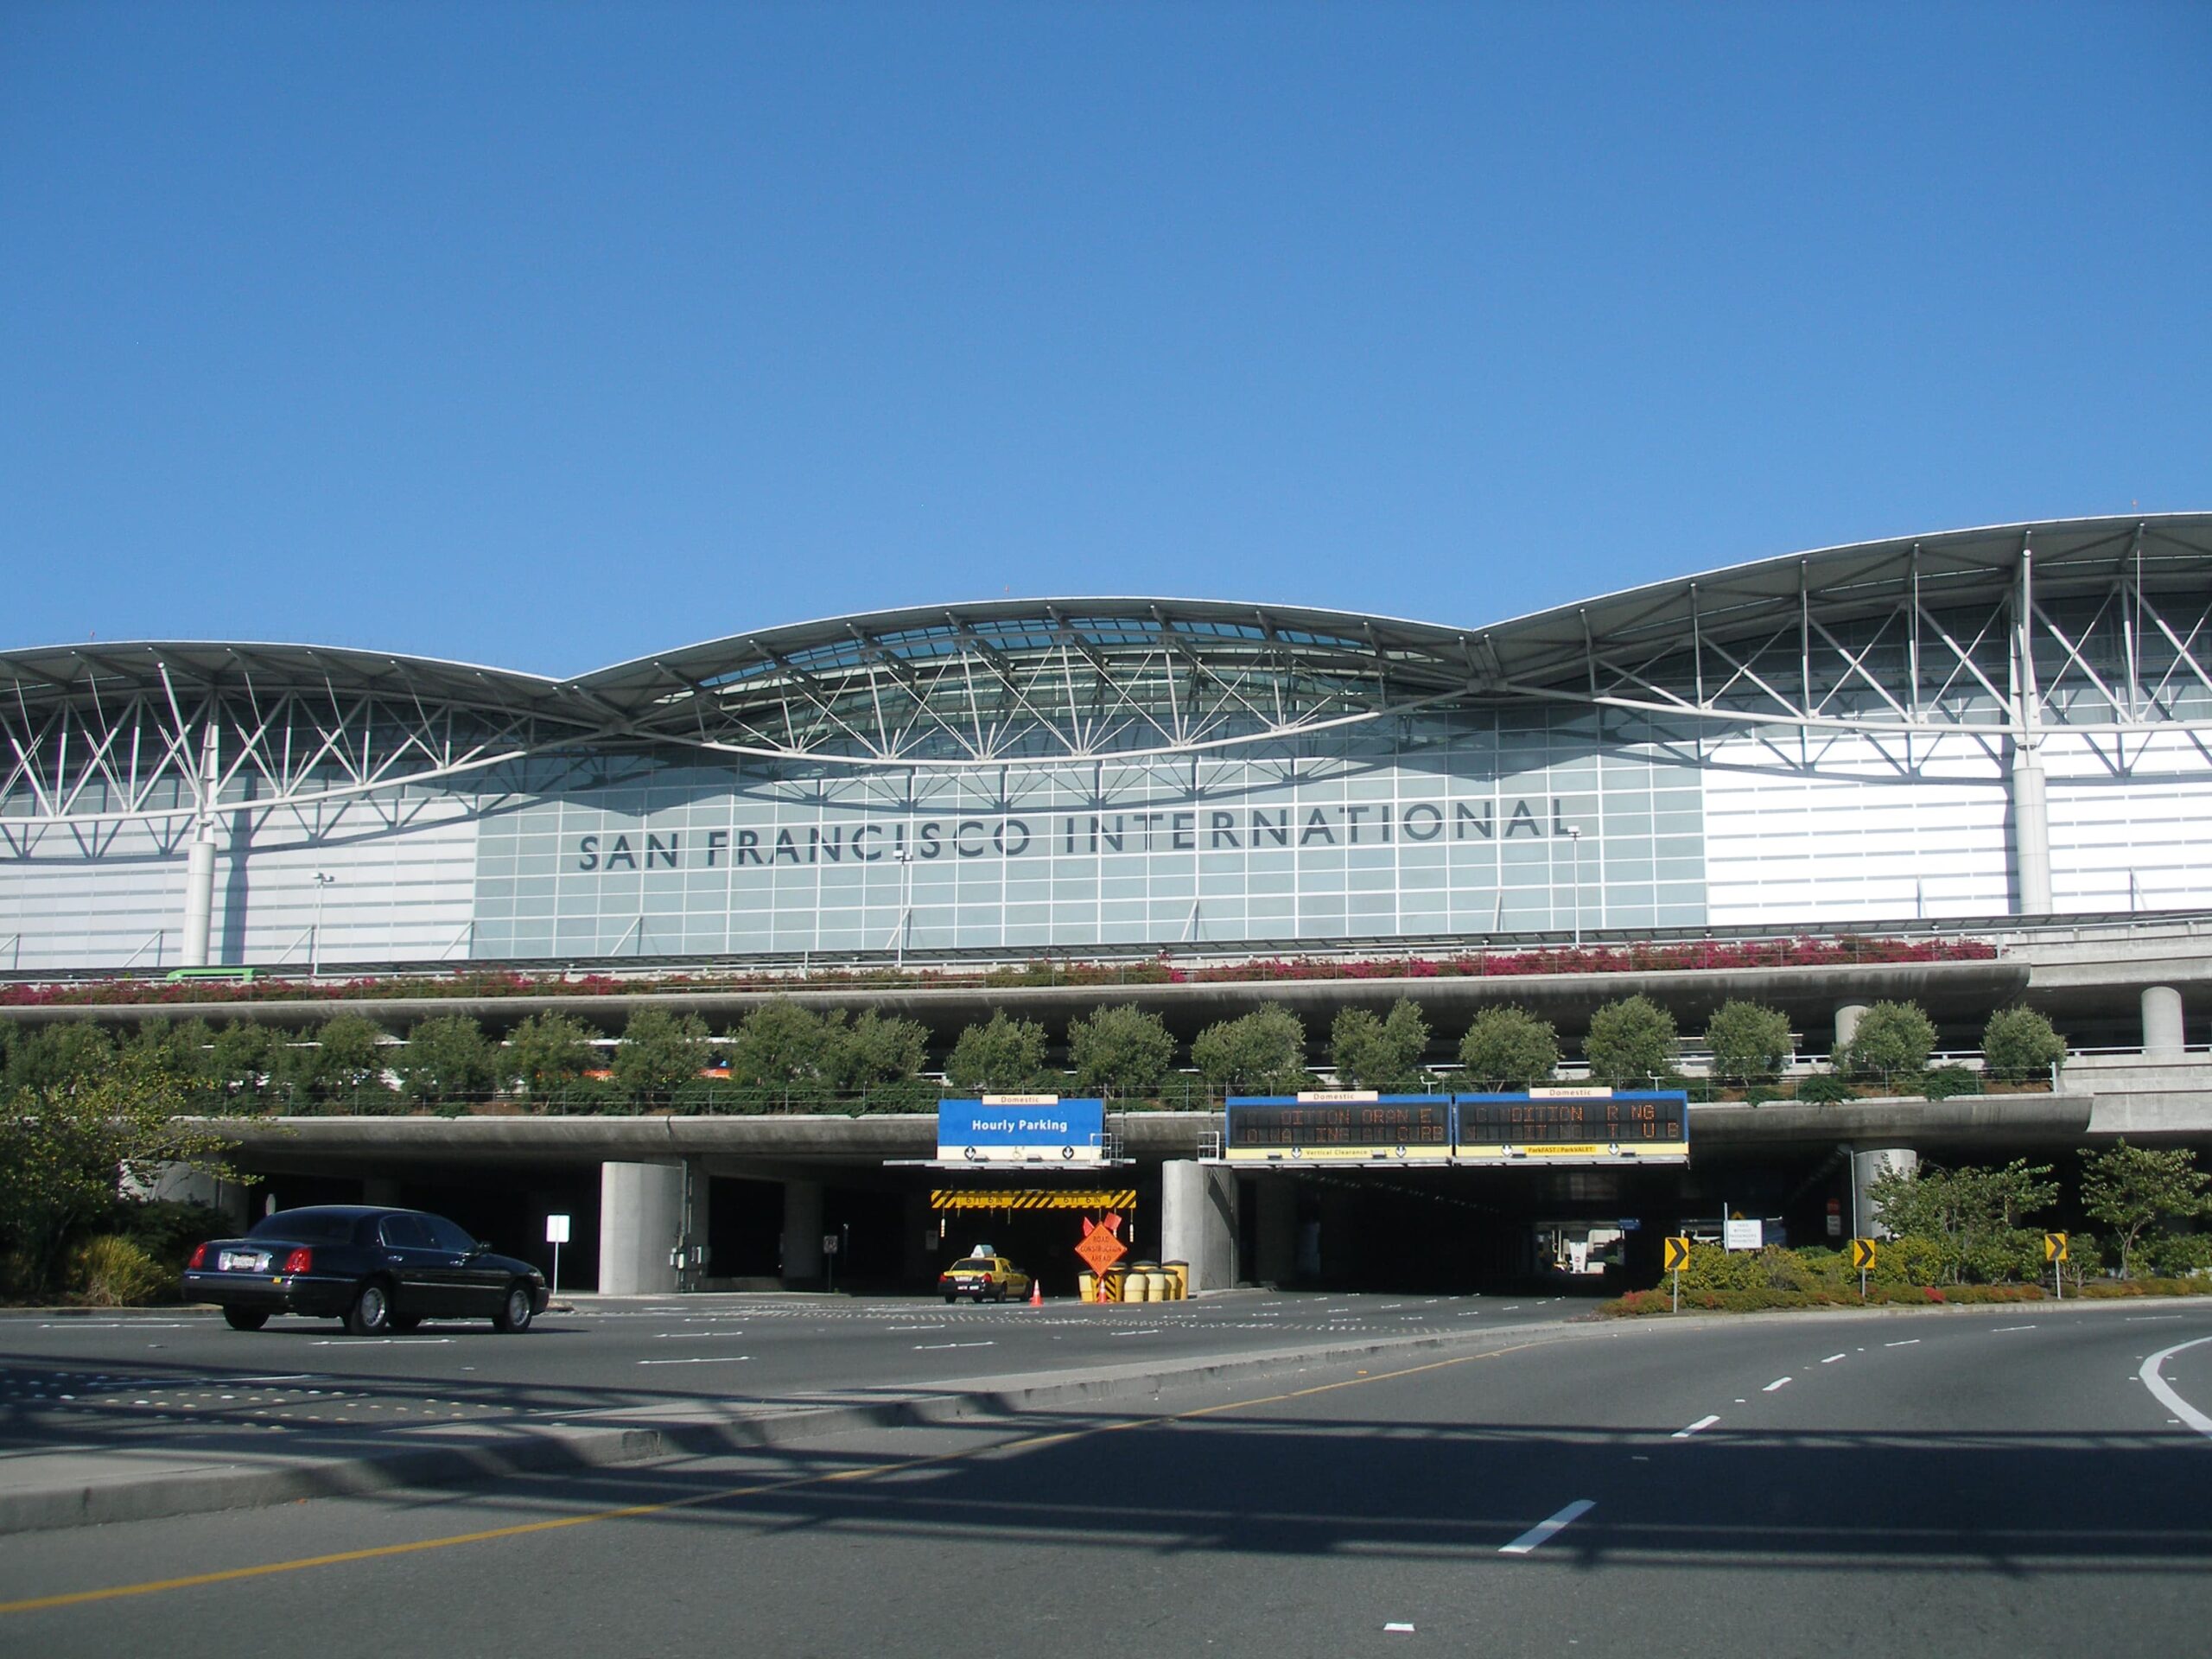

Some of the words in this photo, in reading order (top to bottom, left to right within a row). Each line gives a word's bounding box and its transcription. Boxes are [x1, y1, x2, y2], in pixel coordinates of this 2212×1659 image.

[580, 832, 678, 870] SAN
[708, 818, 1031, 866] FRANCISCO
[1066, 799, 1569, 854] INTERNATIONAL
[1362, 1108, 1432, 1124] ORANE
[972, 1119, 1014, 1133] Hourly
[1019, 1119, 1068, 1133] Parking
